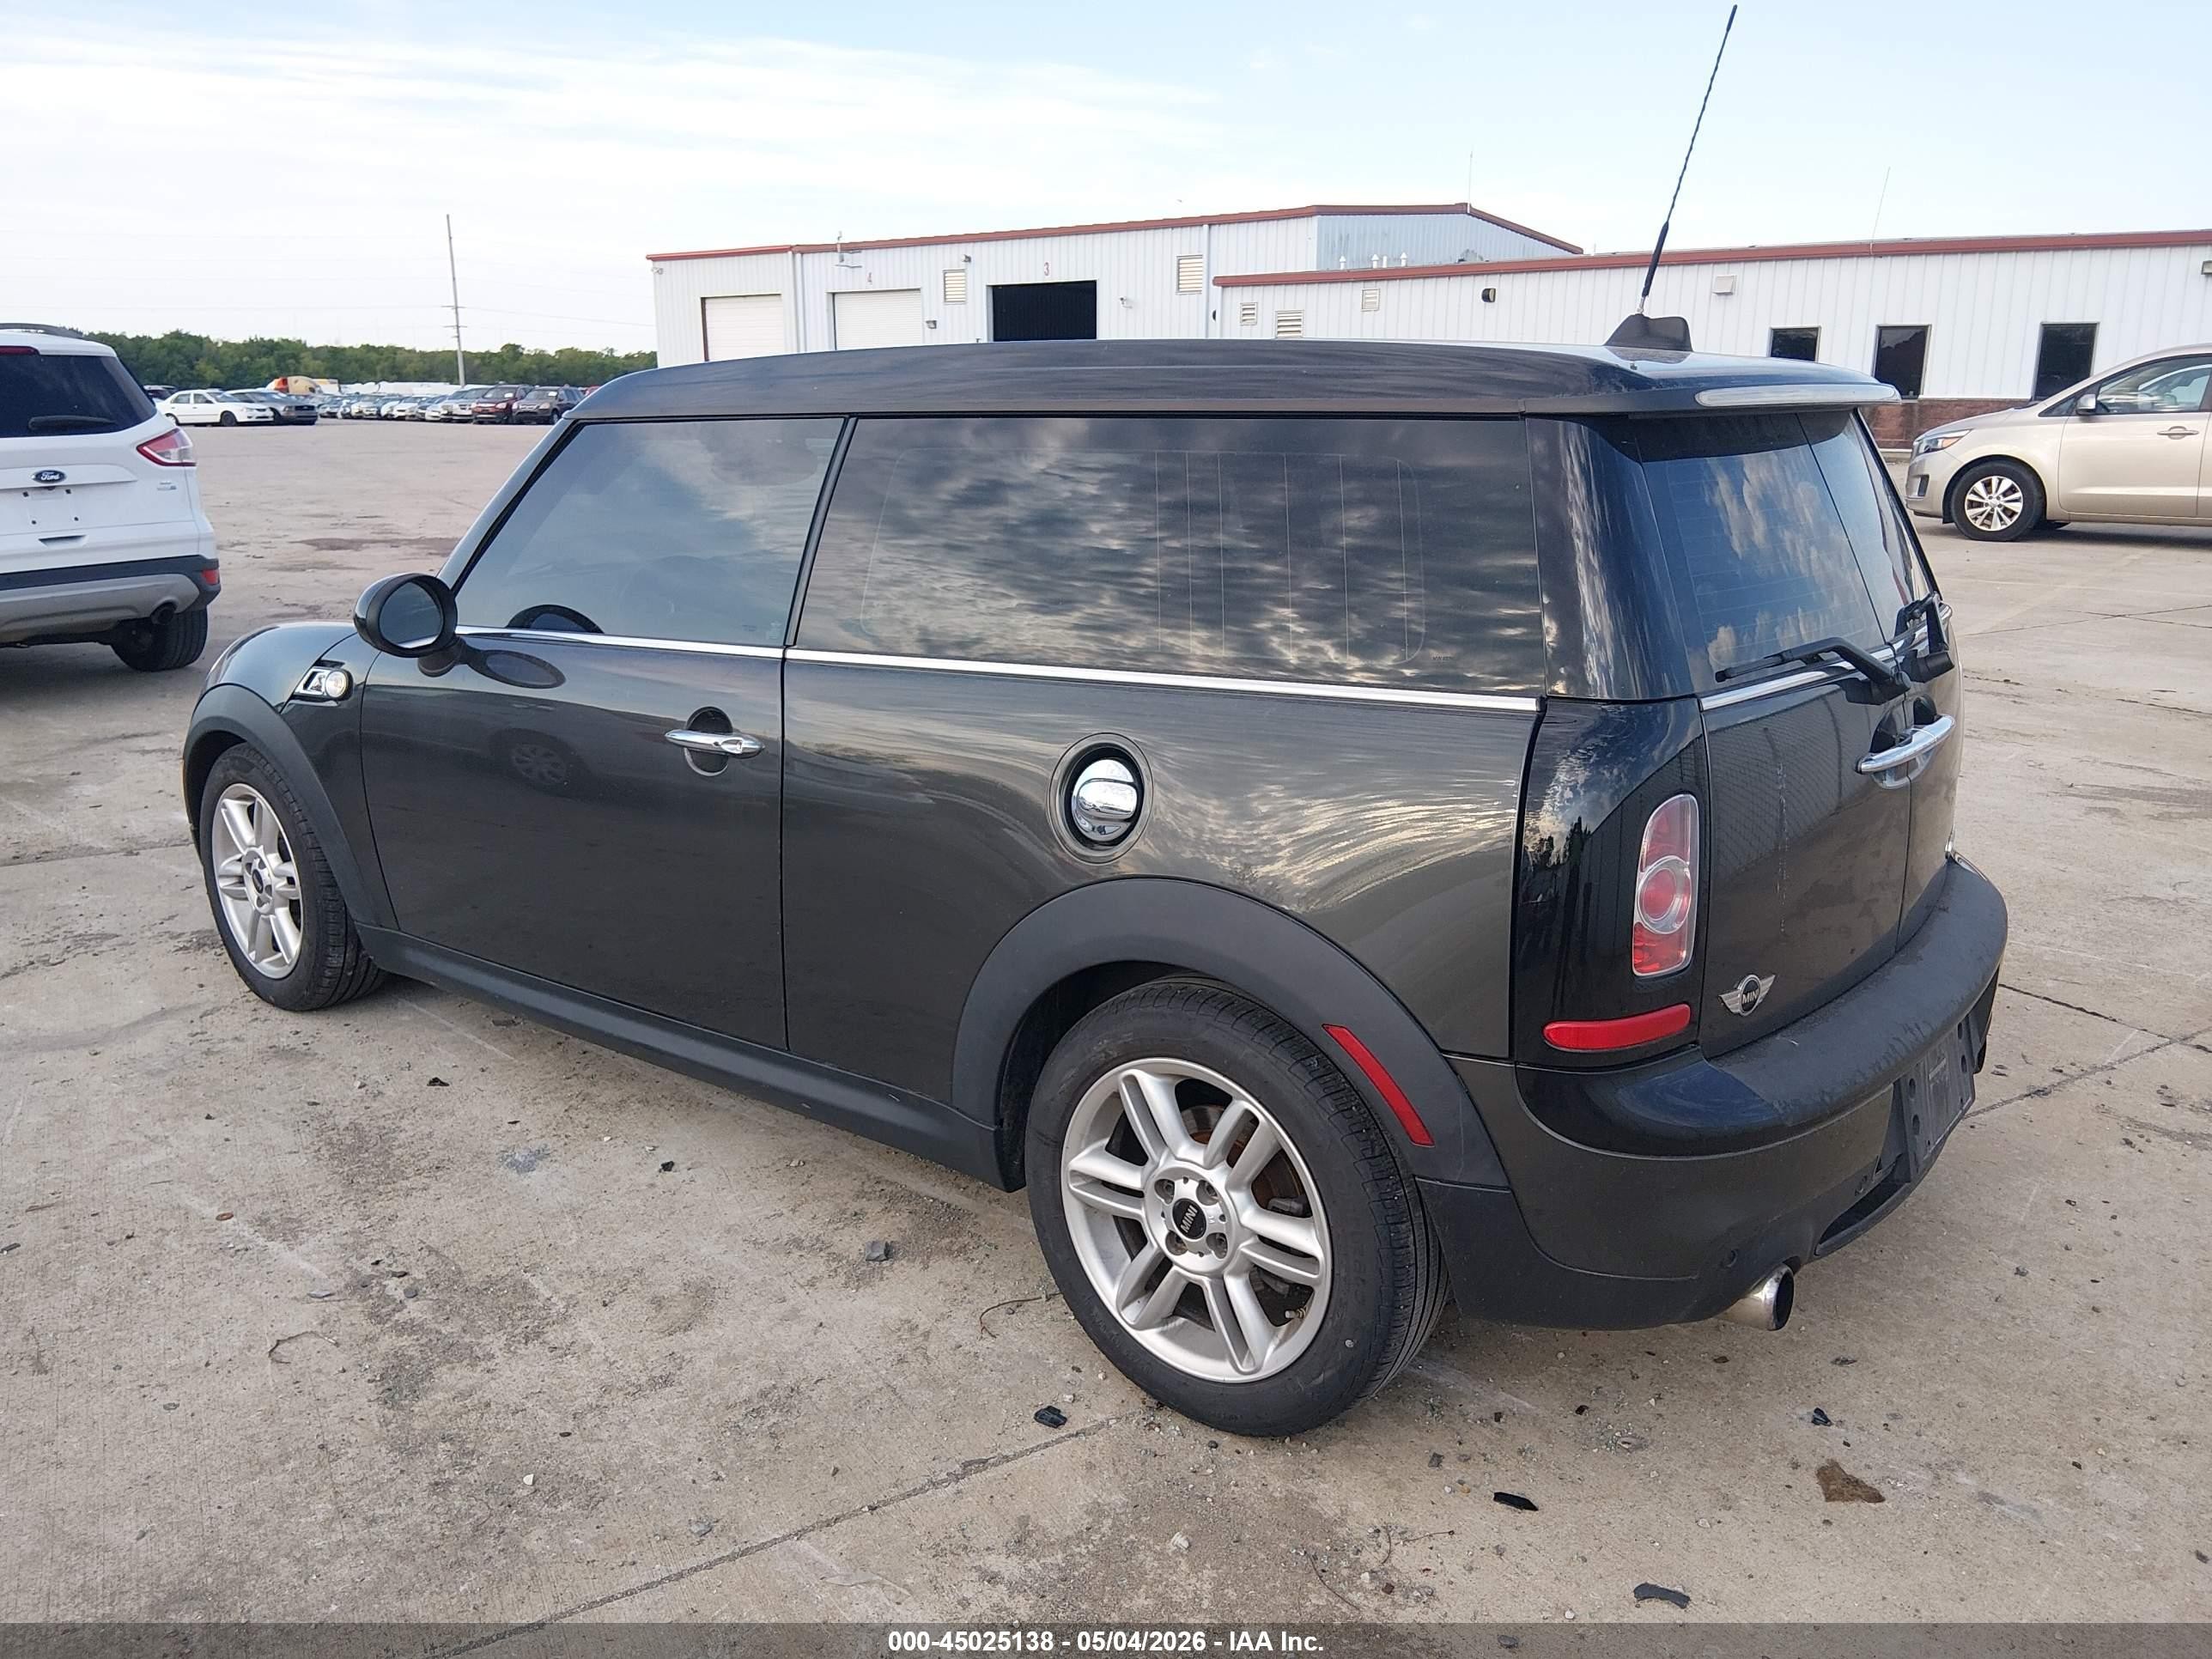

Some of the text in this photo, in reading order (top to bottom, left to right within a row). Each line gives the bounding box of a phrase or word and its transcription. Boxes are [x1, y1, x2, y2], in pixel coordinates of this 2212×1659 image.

[1043, 261, 1050, 276] 3
[1742, 988, 1759, 1004] MINI
[1180, 1205, 1198, 1233] MINI
